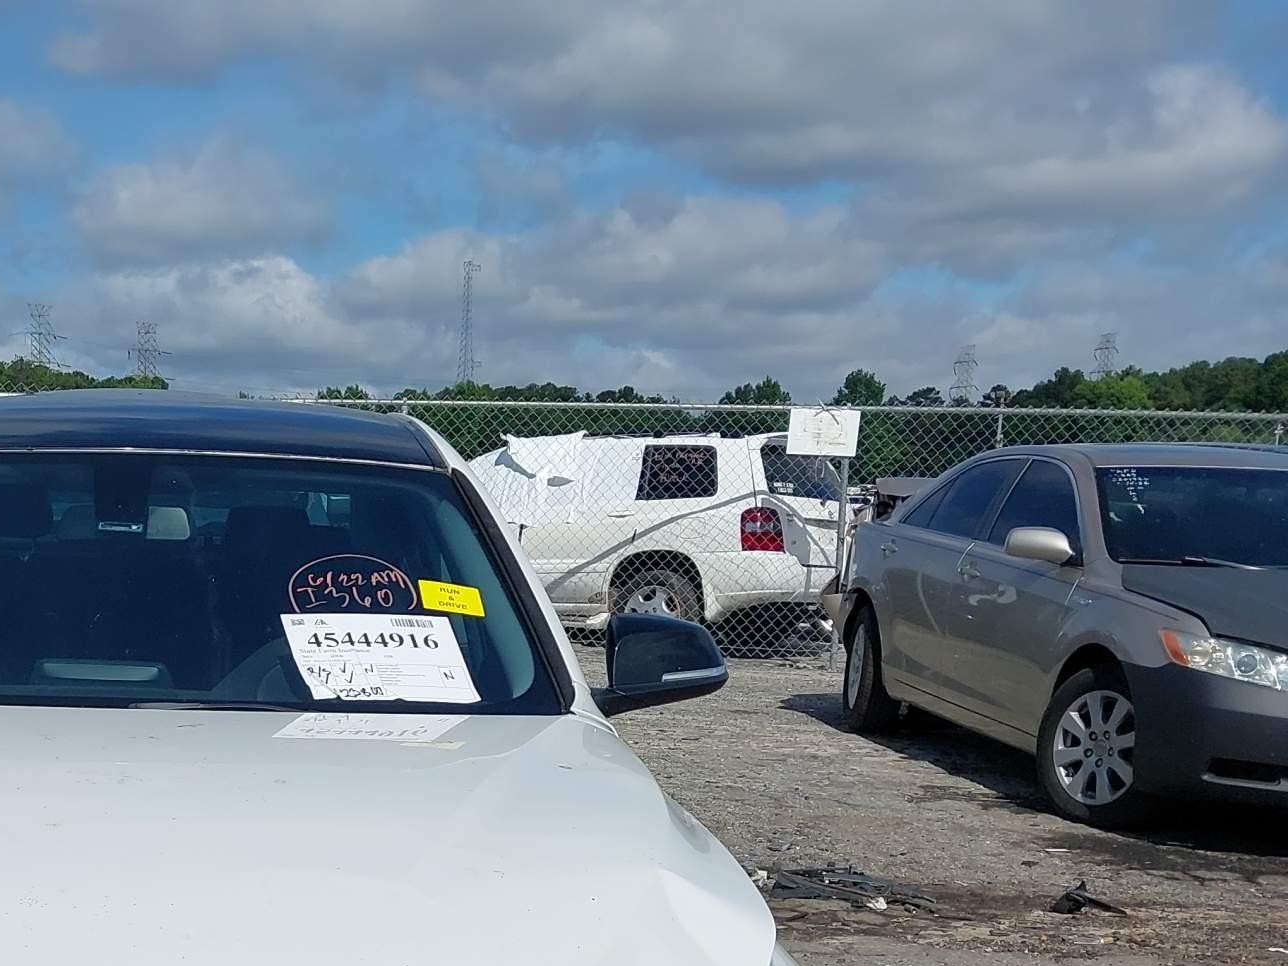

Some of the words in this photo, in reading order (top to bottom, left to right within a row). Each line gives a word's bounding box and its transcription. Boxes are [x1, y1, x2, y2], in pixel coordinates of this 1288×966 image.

[439, 587, 460, 595] RUN
[438, 600, 468, 610] DRIVE
[307, 632, 439, 649] 45444916
